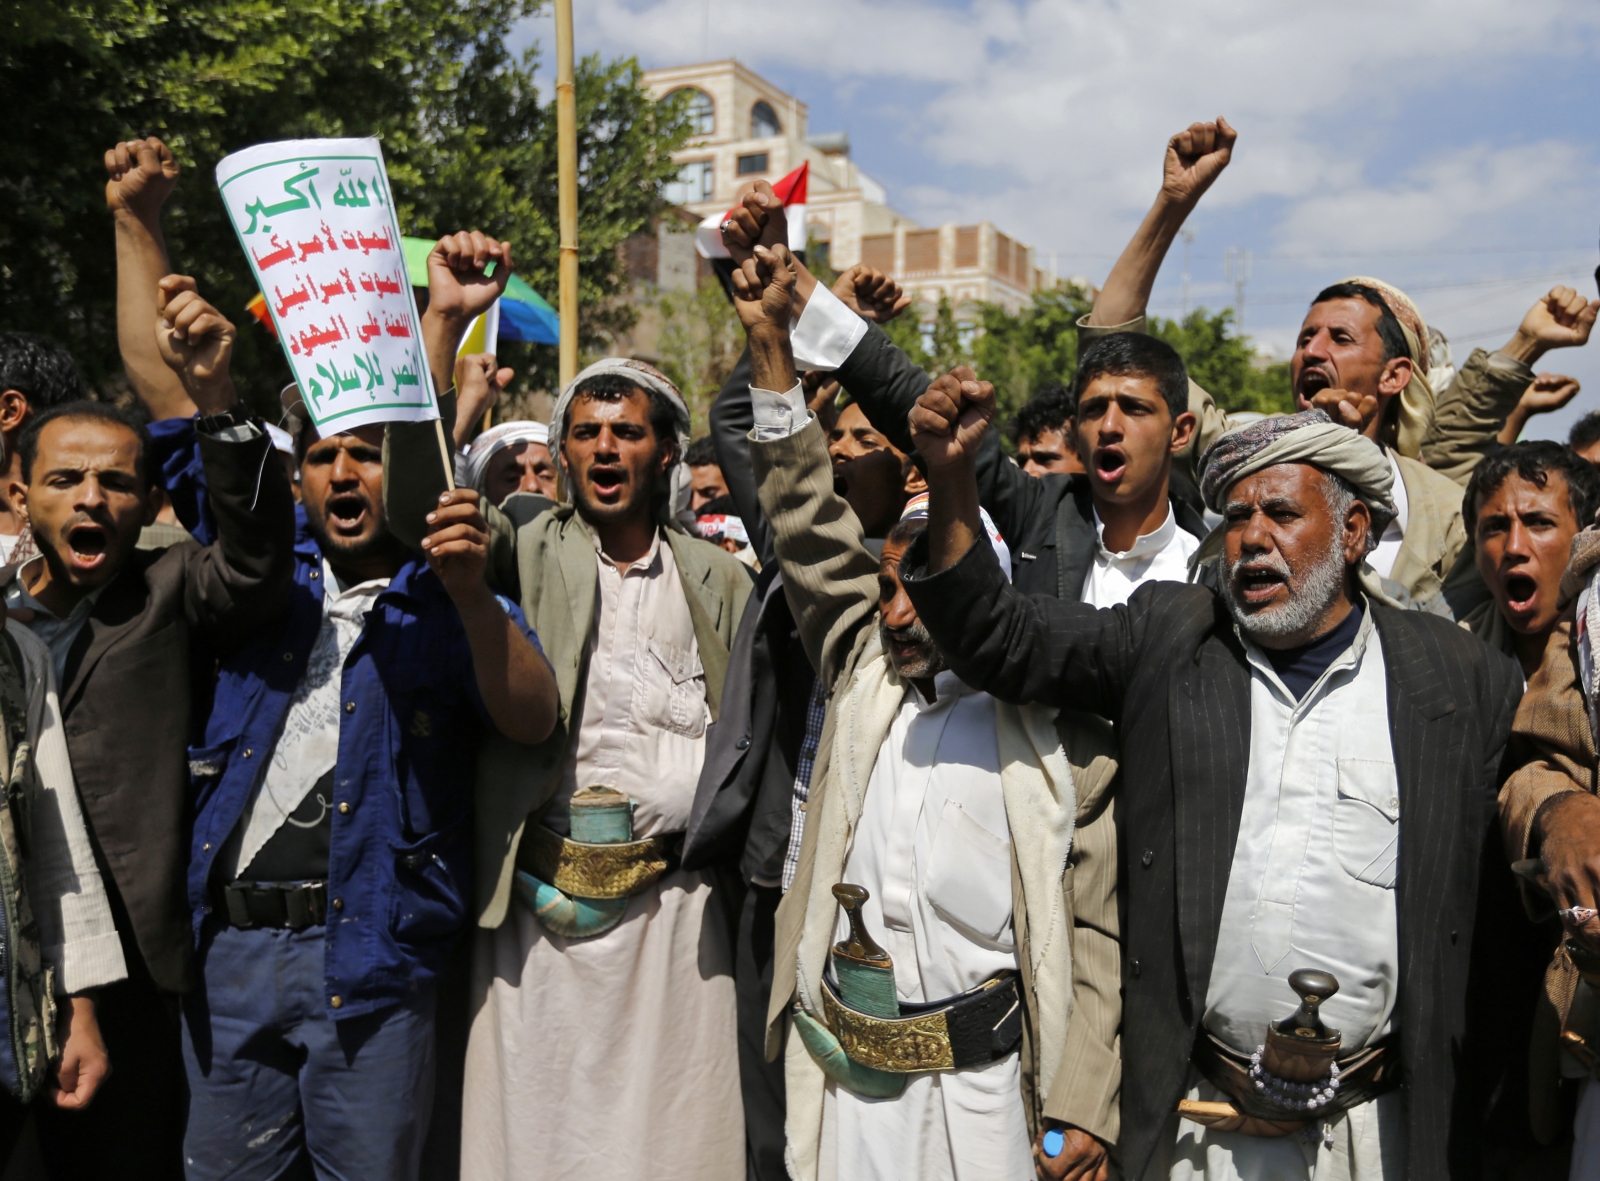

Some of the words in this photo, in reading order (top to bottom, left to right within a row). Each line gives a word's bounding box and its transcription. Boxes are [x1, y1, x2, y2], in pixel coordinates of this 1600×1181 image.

[242, 162, 322, 235] أكبر
[333, 167, 384, 208] الله
[252, 219, 339, 271] لأمريكا
[341, 226, 395, 256] الموت
[275, 268, 357, 318] لإسرائيل
[359, 269, 405, 299] الموت
[290, 313, 350, 357] اليهود
[356, 310, 382, 343] على
[382, 310, 414, 338] اللعنة
[308, 351, 385, 413] للإسلام
[391, 348, 422, 397] النصر
